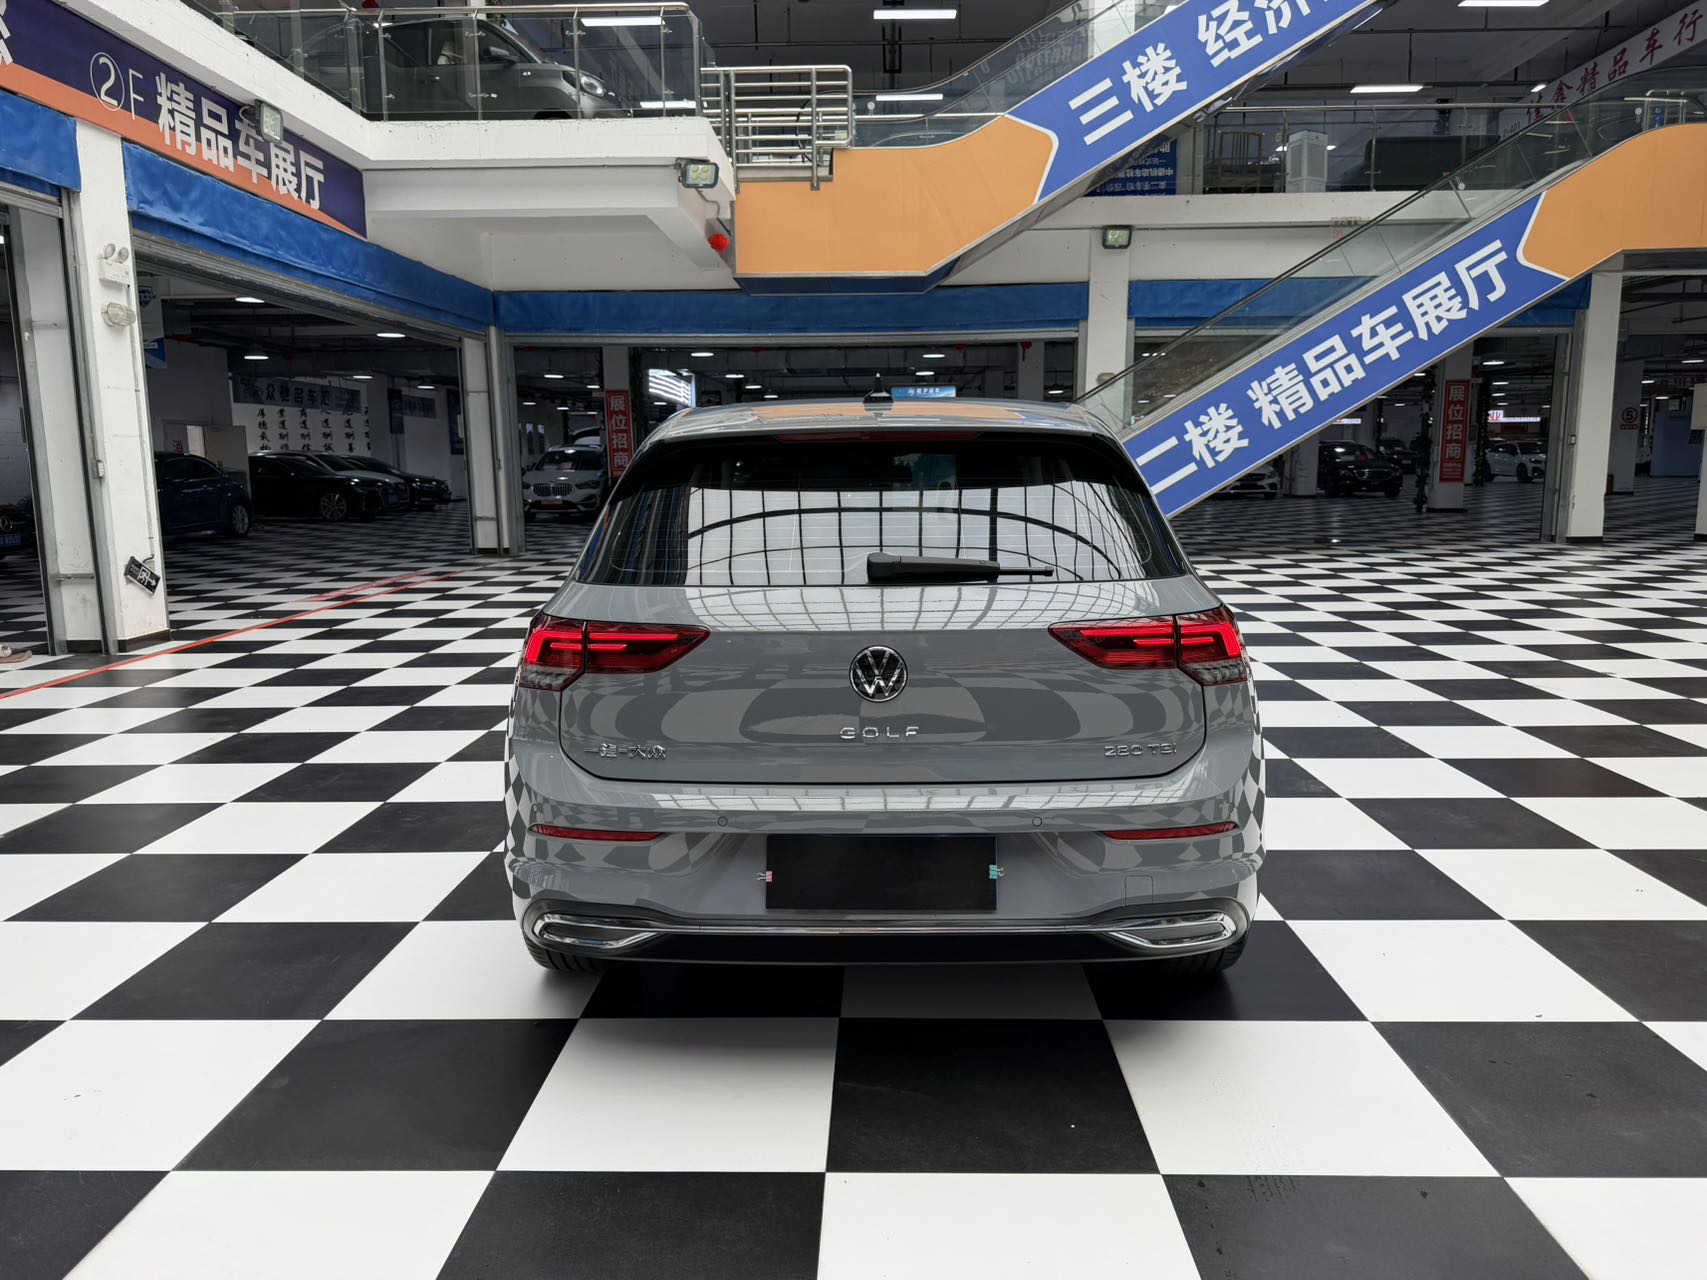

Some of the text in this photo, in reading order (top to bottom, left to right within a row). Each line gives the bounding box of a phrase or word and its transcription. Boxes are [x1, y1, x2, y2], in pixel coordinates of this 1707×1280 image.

[1067, 42, 1188, 146] 三楼
[155, 71, 325, 211] 精品车展厅
[1135, 239, 1510, 495] 二楼 精品车展厅
[610, 395, 629, 468] 展位招商
[1445, 385, 1465, 460] 展位招商
[839, 726, 919, 739] GOLF
[1104, 742, 1177, 757] 280 TSI
